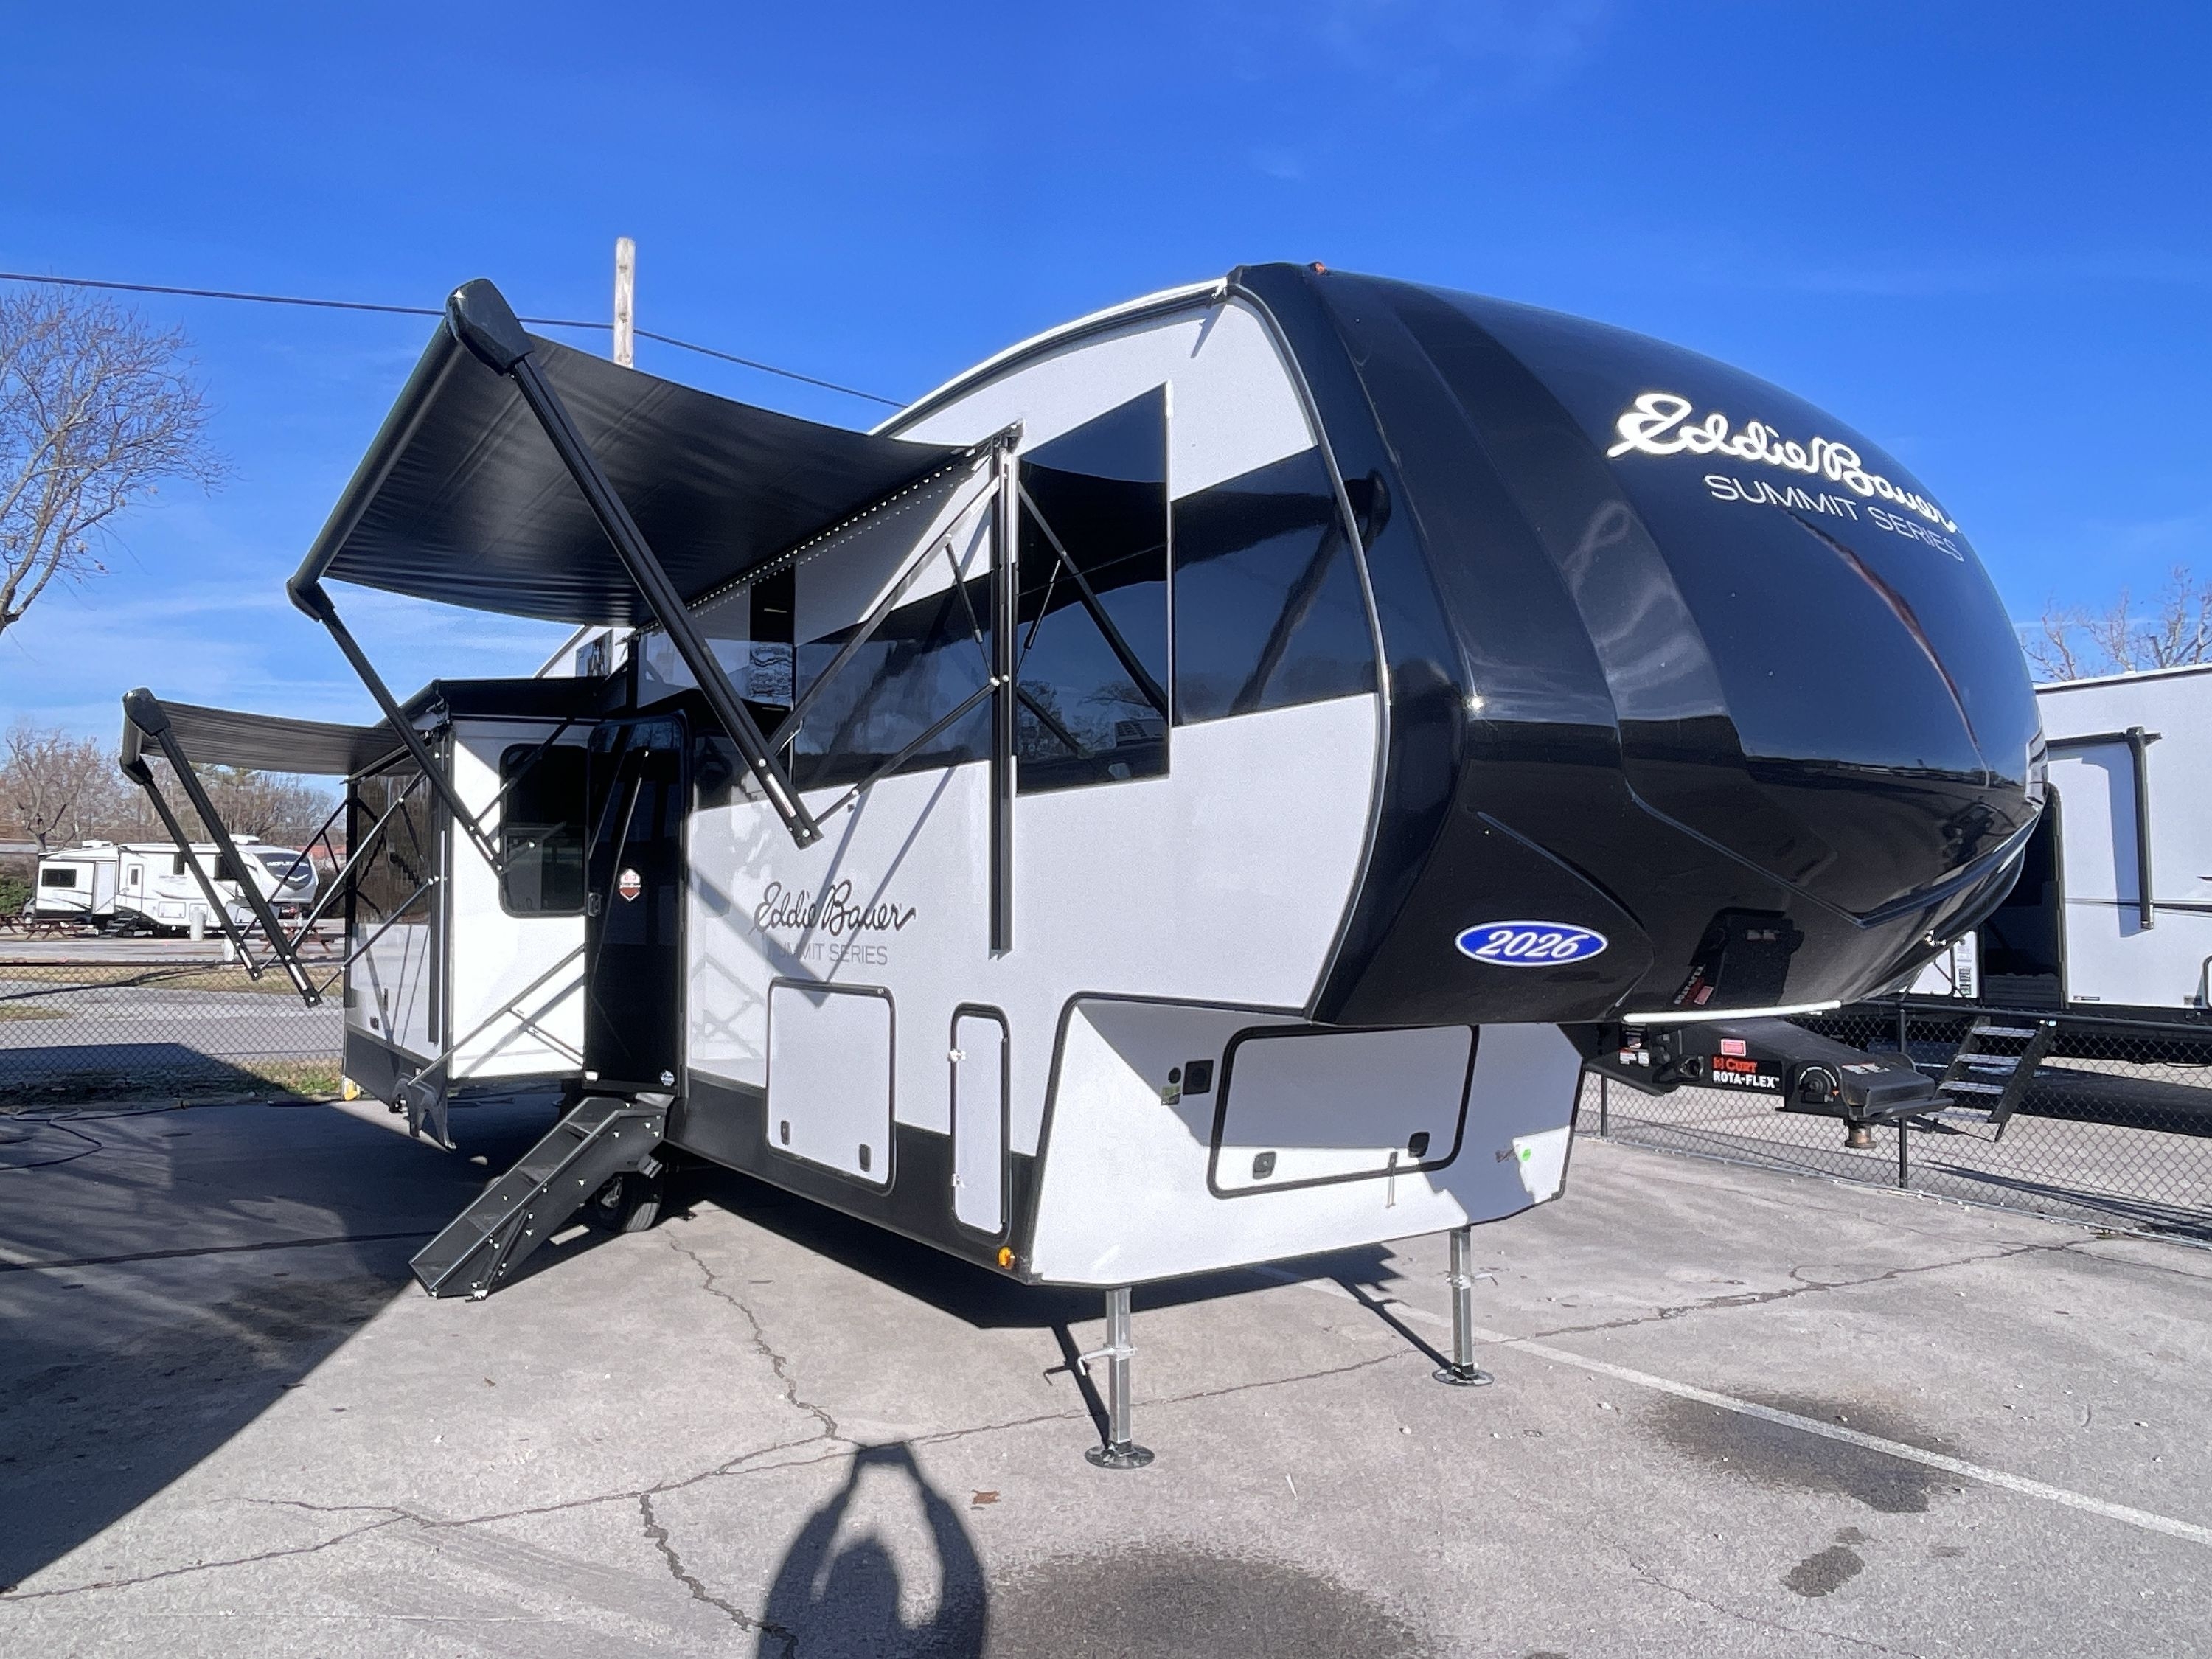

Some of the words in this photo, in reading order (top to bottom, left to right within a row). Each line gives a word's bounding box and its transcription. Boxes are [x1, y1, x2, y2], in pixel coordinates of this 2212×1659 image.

[1607, 393, 1808, 472] Eddie
[1806, 437, 1961, 532] Bauer
[1704, 474, 1859, 521] SUMMIT
[1867, 506, 1964, 562] SERIES
[748, 881, 818, 936] Eddie
[820, 879, 916, 936] Bauer
[829, 943, 888, 966] SERIES
[1475, 930, 1590, 958] 2026
